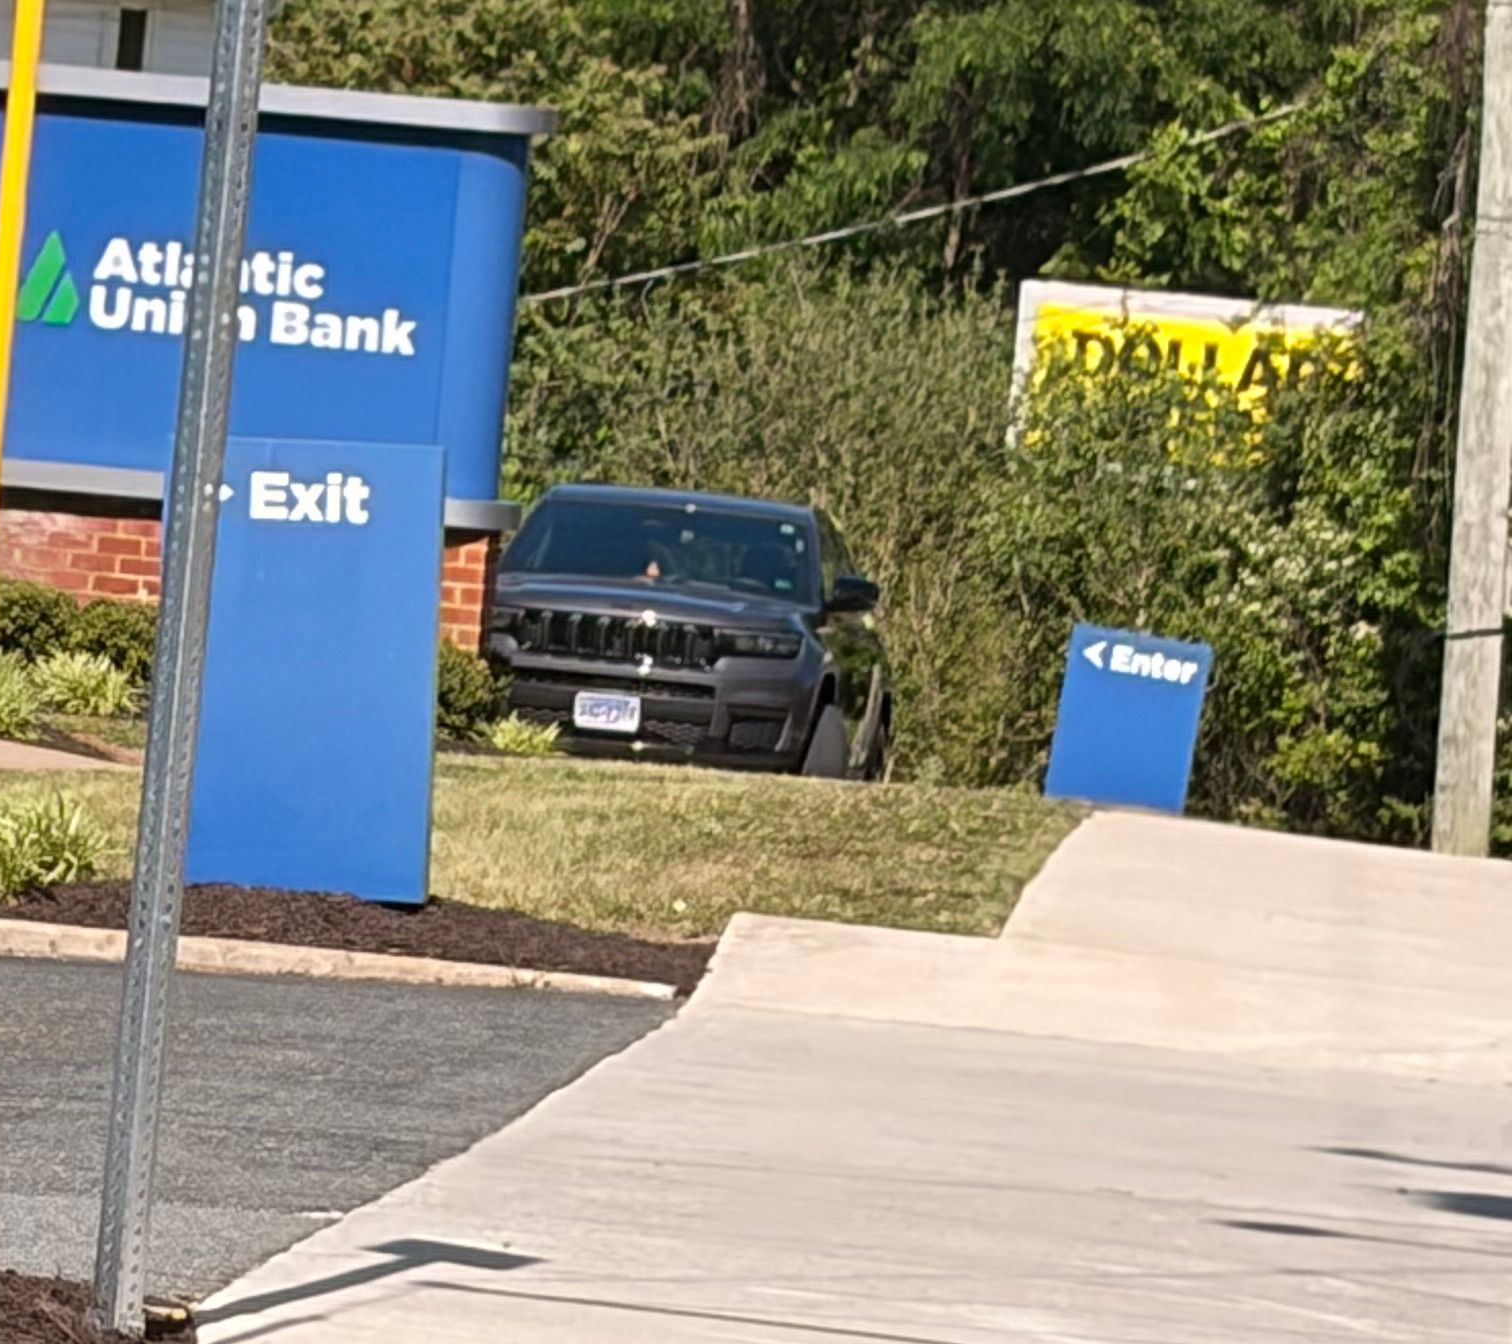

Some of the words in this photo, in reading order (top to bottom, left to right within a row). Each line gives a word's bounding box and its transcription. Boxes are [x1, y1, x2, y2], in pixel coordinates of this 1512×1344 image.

[92, 237, 326, 301] Atltic
[88, 284, 257, 342] Unin
[269, 300, 417, 356] Bank
[249, 470, 371, 526] Exit
[1109, 643, 1199, 686] Enter
